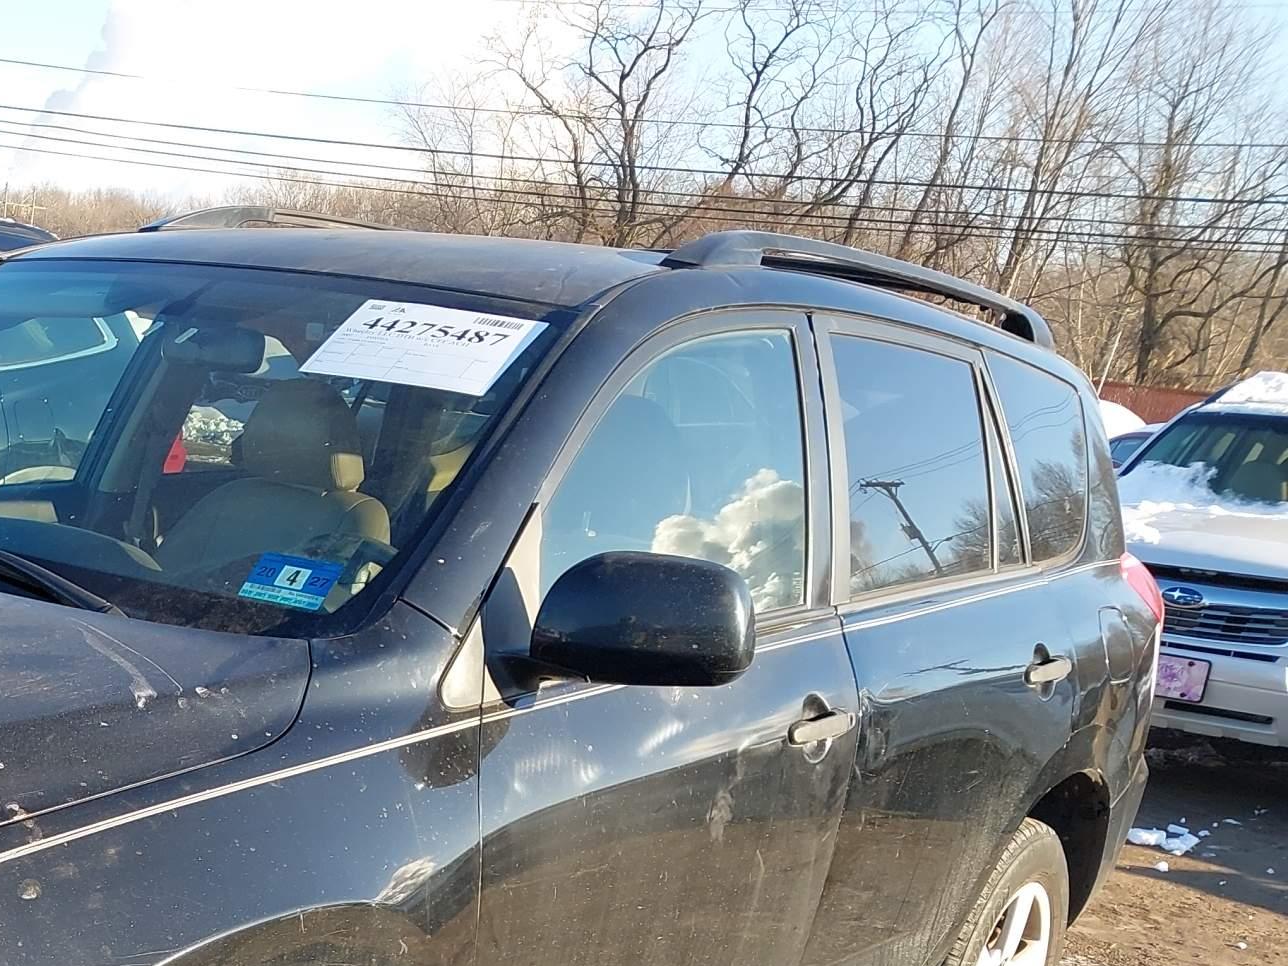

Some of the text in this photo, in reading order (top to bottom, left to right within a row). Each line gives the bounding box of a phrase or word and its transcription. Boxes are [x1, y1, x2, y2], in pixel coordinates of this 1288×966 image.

[362, 316, 510, 345] 44275487
[256, 567, 329, 587] 20 4 27
